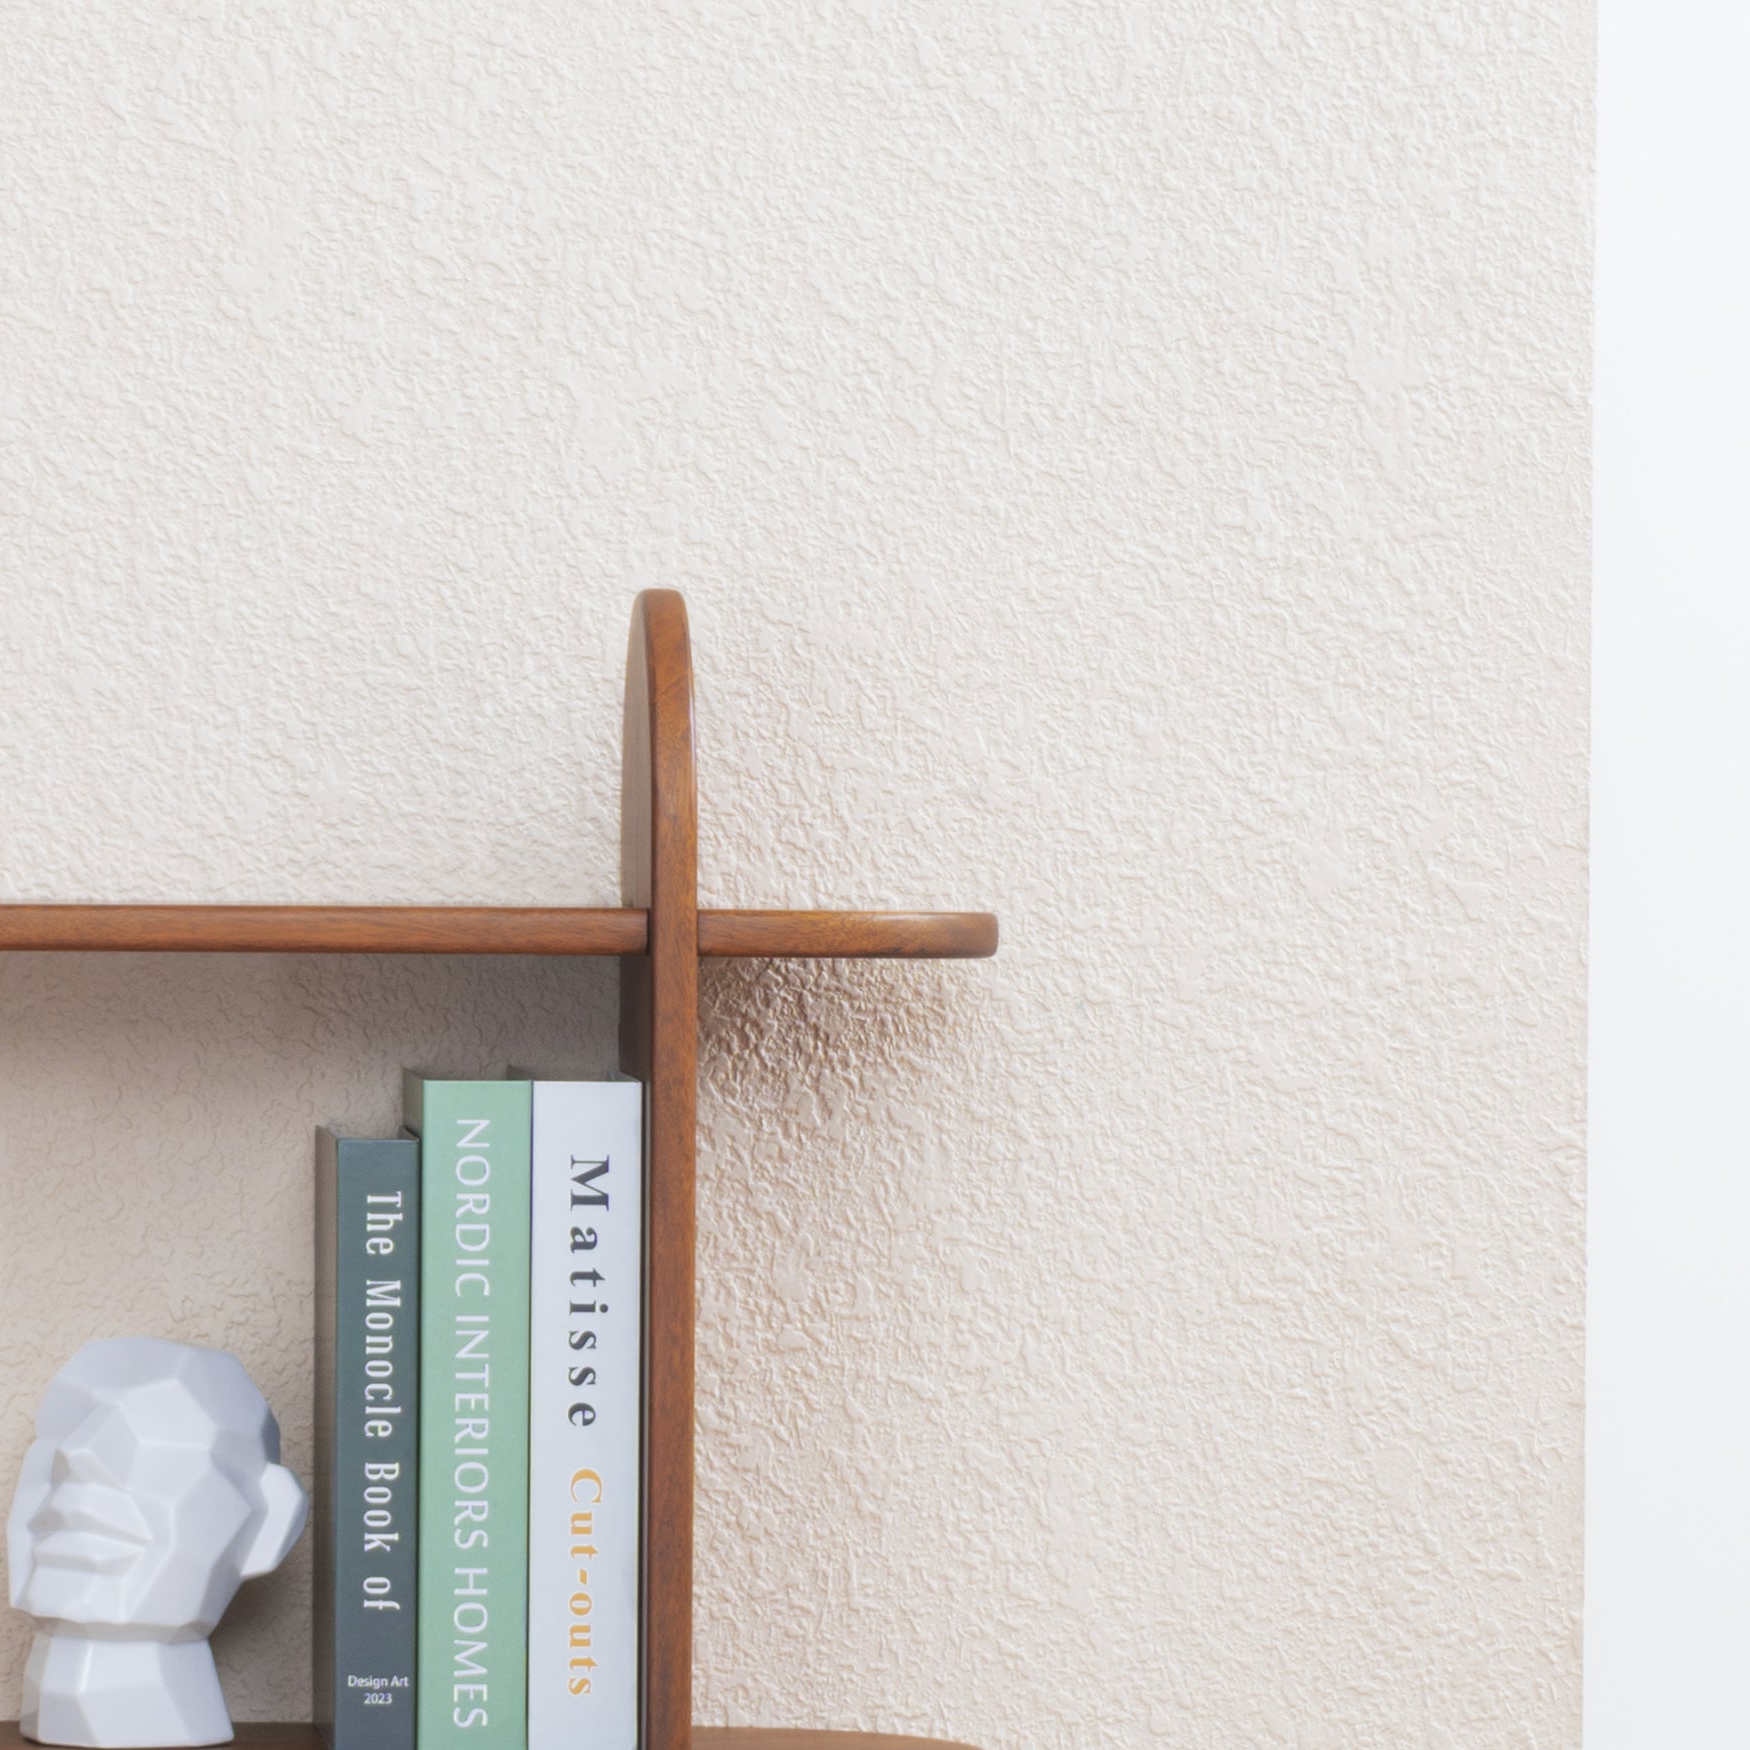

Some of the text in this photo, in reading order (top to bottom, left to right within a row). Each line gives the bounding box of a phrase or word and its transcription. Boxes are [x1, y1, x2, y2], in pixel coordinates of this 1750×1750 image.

[362, 1190, 404, 1611] The Monocle Book of
[453, 1118, 491, 1728] NORDIC INTERIORS HOMES
[568, 1154, 610, 1696] Matisse Cut-outs
[347, 1674, 409, 1690] Design Art
[363, 1692, 393, 1705] 2023
